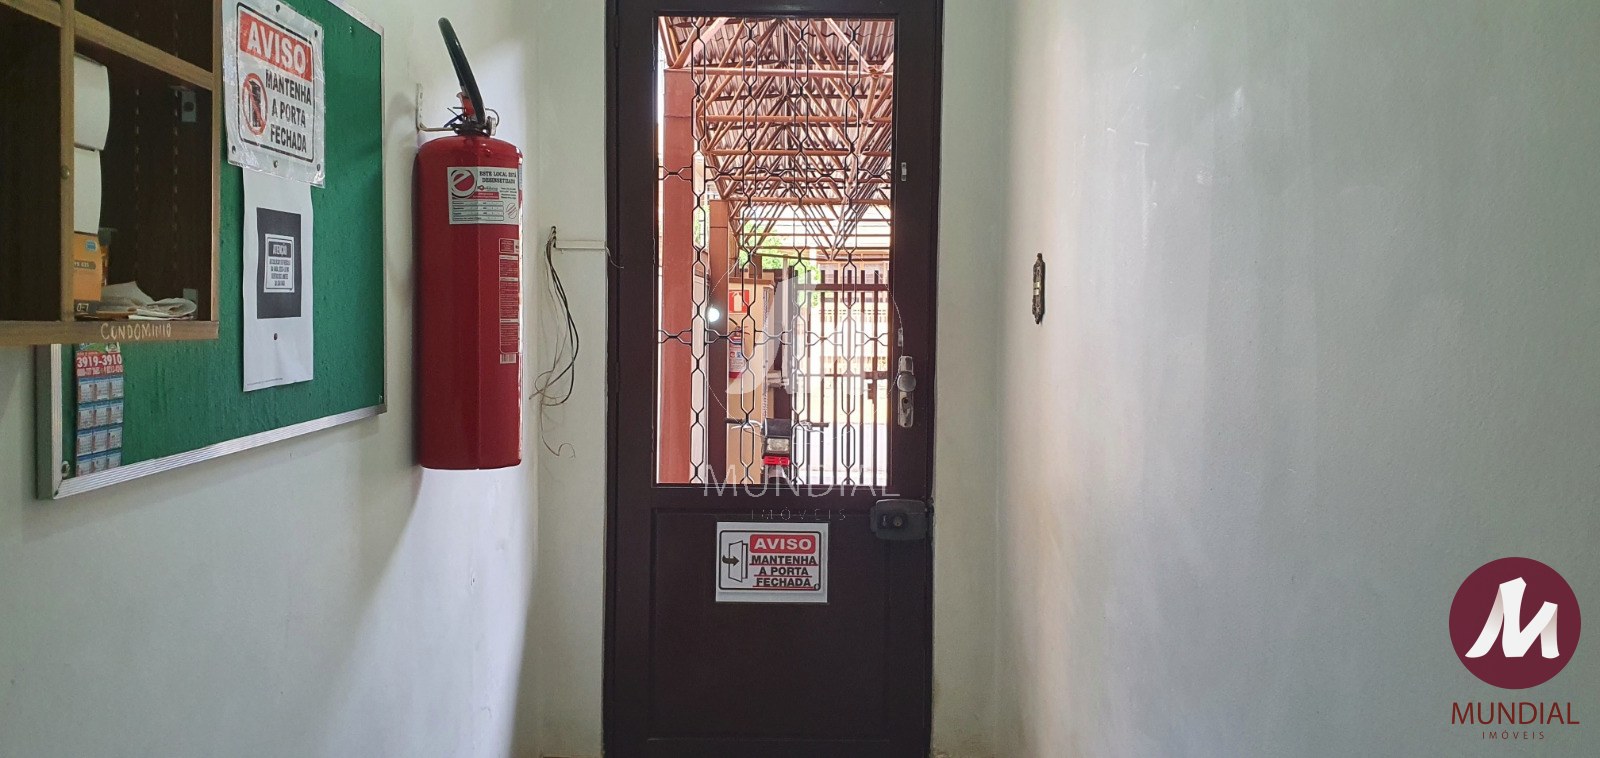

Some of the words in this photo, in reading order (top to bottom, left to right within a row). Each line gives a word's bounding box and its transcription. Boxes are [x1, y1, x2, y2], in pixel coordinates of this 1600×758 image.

[247, 21, 307, 75] AVISO
[265, 69, 312, 106] MANTENHA
[271, 98, 279, 118] A
[279, 101, 306, 129] PORTA
[270, 124, 307, 154] FECHADA
[100, 322, 172, 340] CONDOMINIO
[76, 353, 123, 368] 3919-3910
[753, 537, 812, 551] AVISO
[751, 554, 817, 565] MANTENHA
[758, 566, 768, 576] A
[770, 566, 809, 576] PORTA
[756, 577, 811, 587] FECHADA
